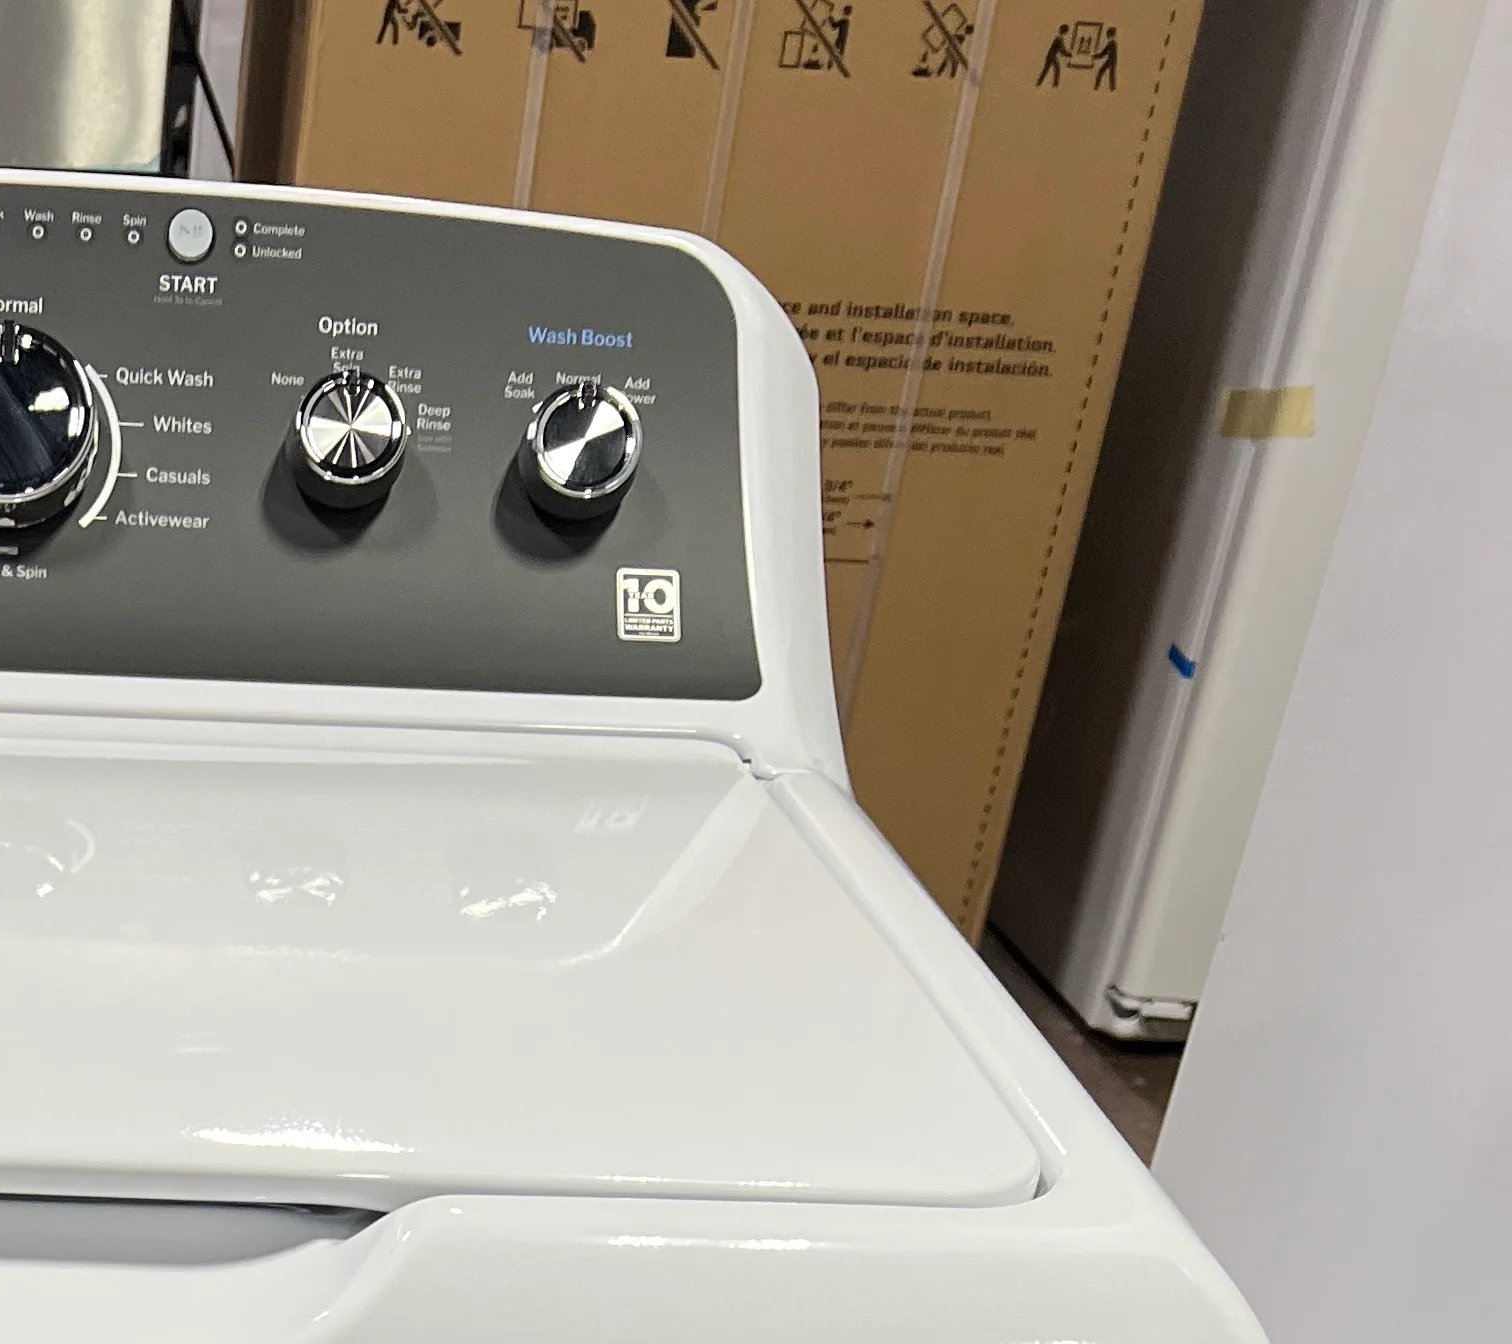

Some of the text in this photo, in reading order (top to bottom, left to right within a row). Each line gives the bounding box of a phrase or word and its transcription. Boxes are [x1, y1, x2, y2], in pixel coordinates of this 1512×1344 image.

[24, 208, 55, 223] Wash
[71, 211, 102, 225] Rinse
[122, 213, 147, 228] Spin
[253, 222, 306, 237] Complete
[251, 245, 303, 260] Unlocked
[158, 274, 219, 295] START
[807, 300, 843, 317] and
[318, 315, 379, 337] Option
[528, 325, 634, 348] Wash Boost
[826, 327, 845, 342] et
[330, 346, 364, 361] Extra
[823, 350, 841, 366] el
[921, 355, 943, 372] de
[115, 366, 214, 388] Quick Wash
[271, 371, 305, 387] None
[388, 365, 422, 380] Extra
[507, 370, 535, 385] Add
[387, 379, 422, 394] Rinse
[624, 376, 651, 391] Add
[504, 386, 535, 400] Soak
[624, 393, 656, 406] ower
[417, 402, 451, 417] Deep
[153, 415, 213, 434] Whites
[416, 417, 451, 431] Rinse
[145, 466, 211, 486] Casuals
[114, 509, 210, 529] Activewear
[1, 564, 14, 578] &
[16, 564, 48, 580] Spin
[623, 578, 676, 614] 10
